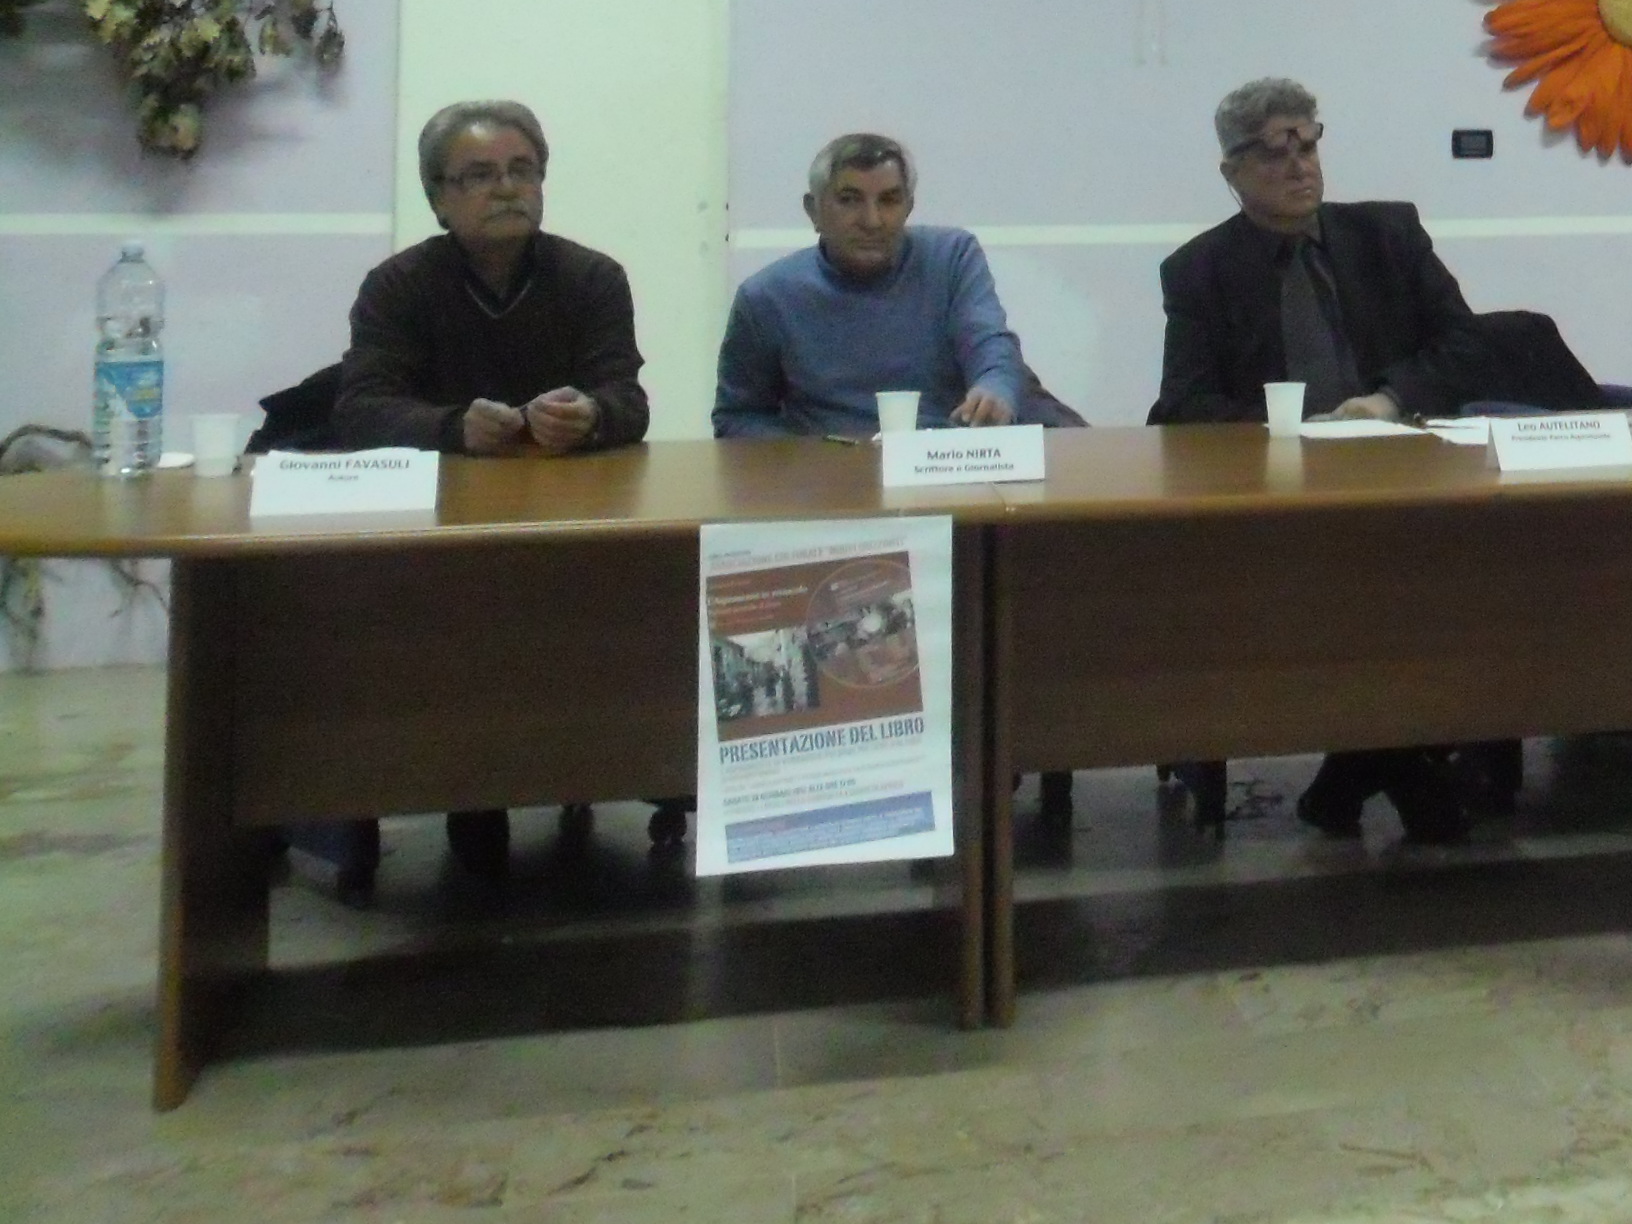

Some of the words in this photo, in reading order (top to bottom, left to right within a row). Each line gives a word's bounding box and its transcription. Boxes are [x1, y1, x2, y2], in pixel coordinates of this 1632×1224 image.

[926, 449, 963, 461] Mario
[966, 447, 1002, 460] NIRTA
[279, 458, 341, 470] Giovanni
[345, 458, 410, 470] FAVASULI
[719, 728, 846, 765] PRESENTAZIONE
[850, 723, 878, 745] DEL
[881, 716, 925, 739] LIBRO
